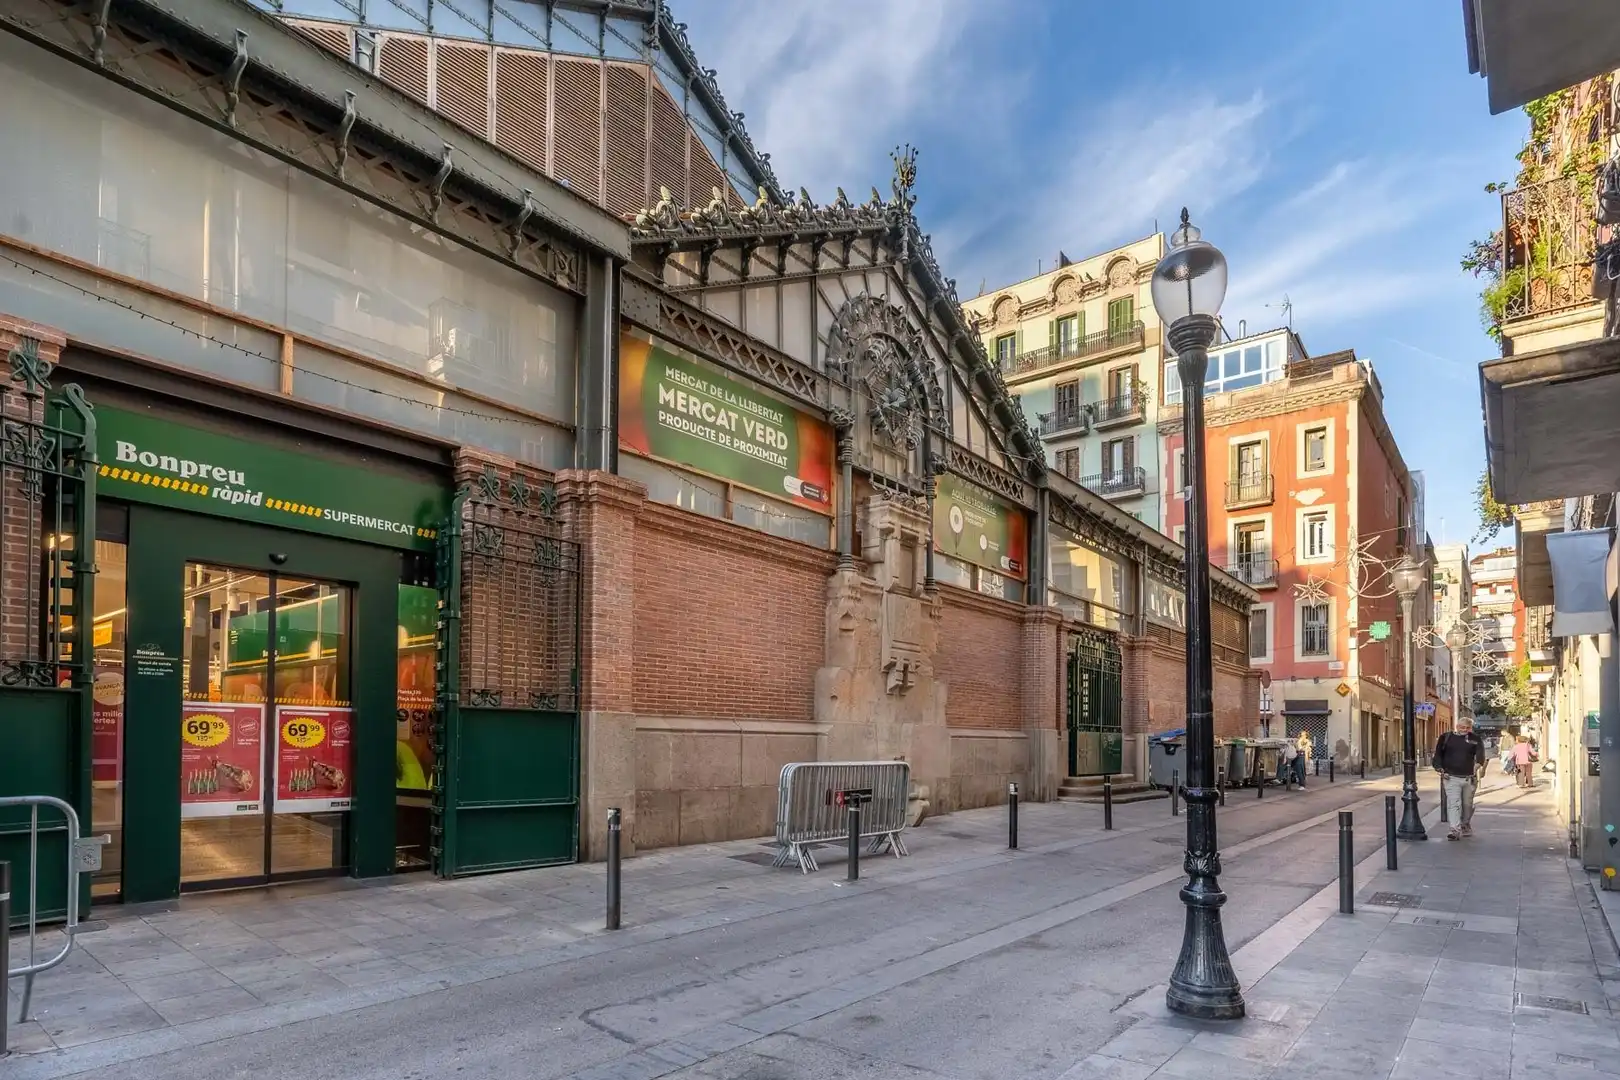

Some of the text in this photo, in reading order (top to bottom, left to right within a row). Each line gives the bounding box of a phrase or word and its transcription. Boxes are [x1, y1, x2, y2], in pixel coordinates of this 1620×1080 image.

[658, 382, 788, 450] MERCAT VERD
[665, 365, 784, 423] MERCAT DE LA LLIBERTAT
[115, 440, 246, 487] Bonpreu
[658, 410, 788, 467] PRODUCTE DE PROXIMITAT
[211, 484, 263, 507] ràpid
[323, 508, 416, 536] SUPERMERCAT
